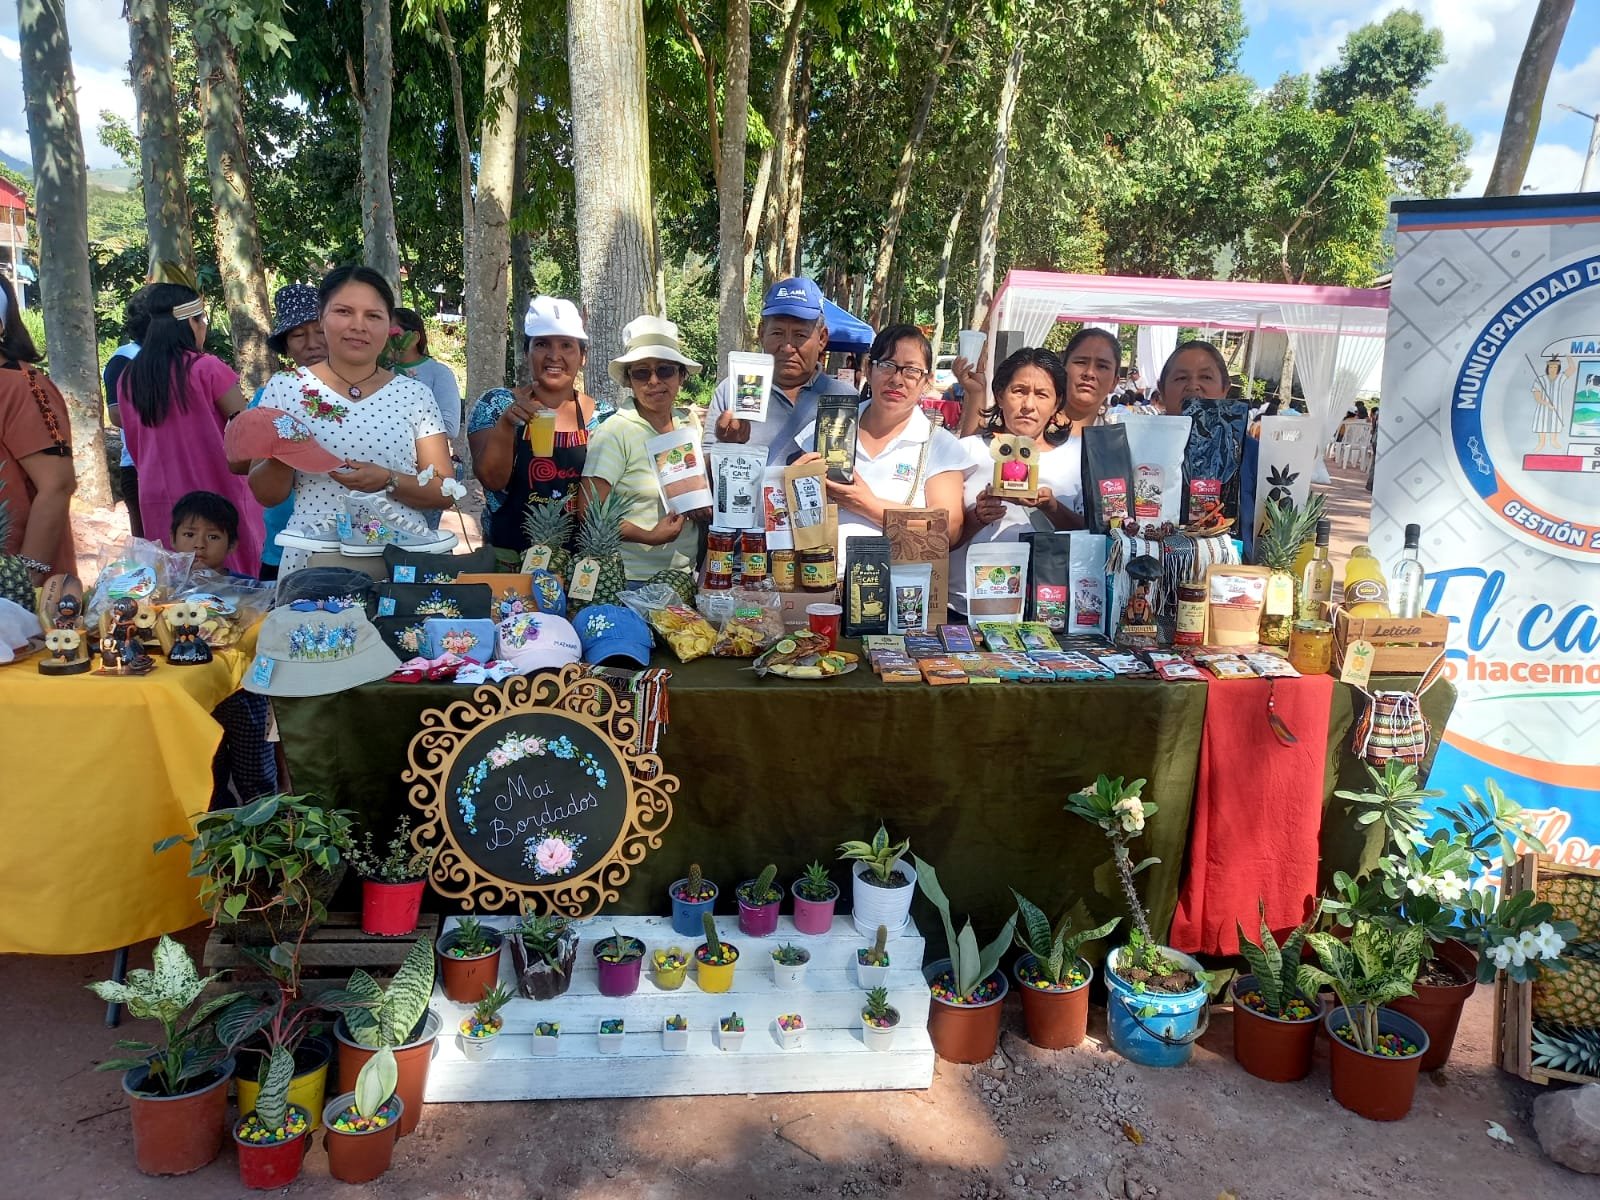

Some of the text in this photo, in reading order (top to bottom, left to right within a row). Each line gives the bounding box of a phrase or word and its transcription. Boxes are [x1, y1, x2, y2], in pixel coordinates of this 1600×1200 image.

[1457, 269, 1581, 409] MUNICIPALIDAD
[1503, 500, 1587, 547] GESTIÓN
[1373, 625, 1422, 637] Leticia
[494, 774, 554, 812] Mai
[486, 791, 599, 850] Bordados
